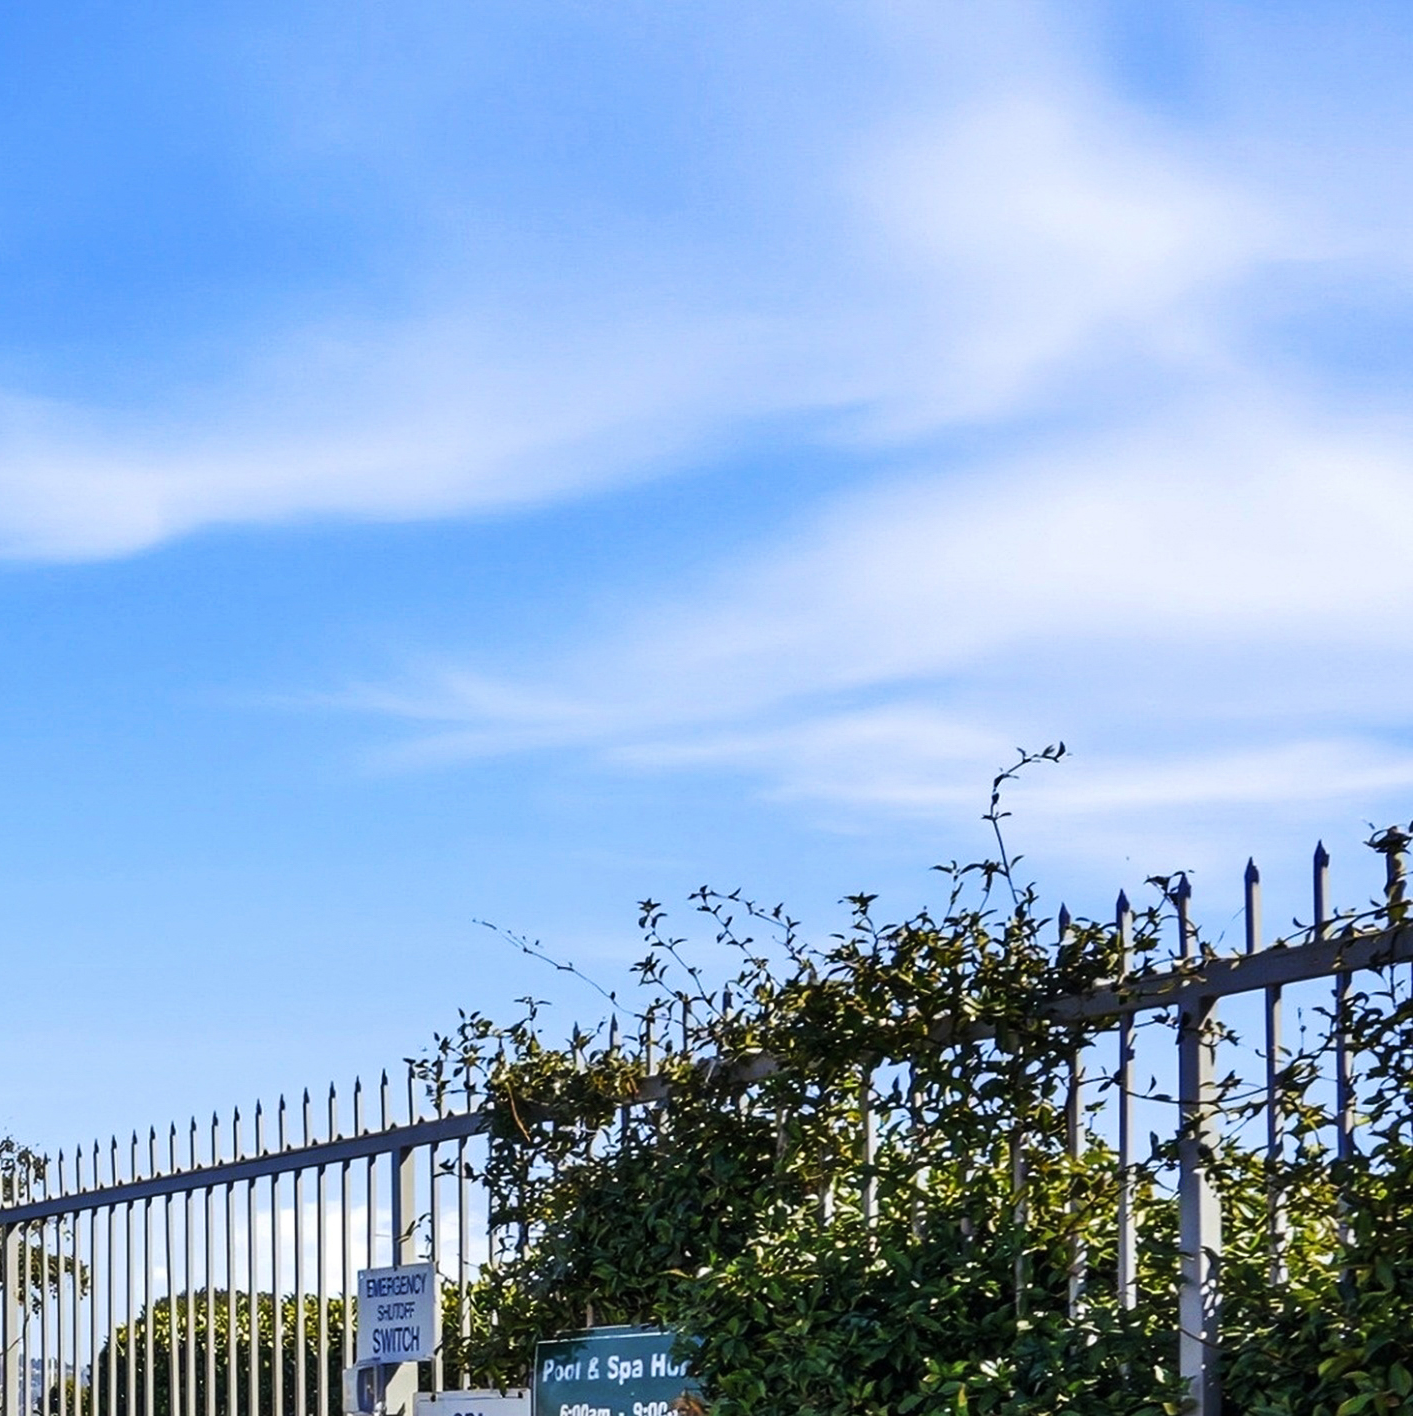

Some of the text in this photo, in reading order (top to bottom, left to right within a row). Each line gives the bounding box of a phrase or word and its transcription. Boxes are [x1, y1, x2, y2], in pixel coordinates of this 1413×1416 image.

[366, 1273, 427, 1298] EMERGENCY
[376, 1301, 416, 1322] SHUTOFF
[372, 1326, 420, 1354] SWITCH
[542, 1358, 581, 1382] Pool
[587, 1356, 600, 1381] &
[607, 1355, 644, 1386] Spa
